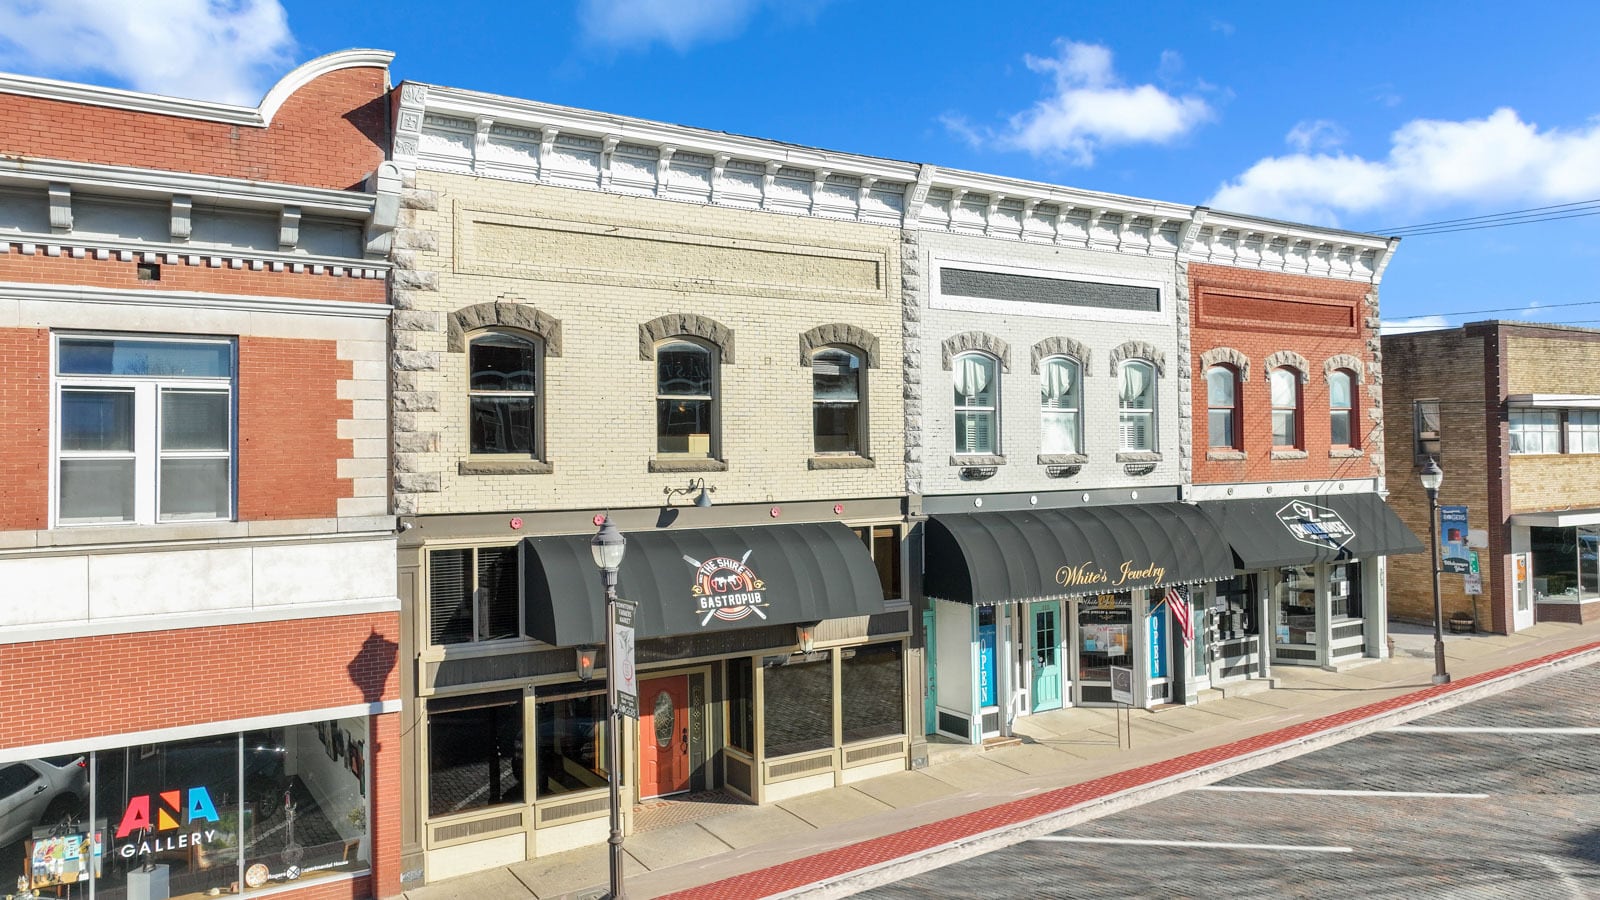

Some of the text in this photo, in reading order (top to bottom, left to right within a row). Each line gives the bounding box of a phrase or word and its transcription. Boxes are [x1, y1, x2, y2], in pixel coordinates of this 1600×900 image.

[701, 558, 744, 576] THE SHIRE
[1055, 560, 1166, 587] White's Jewelry
[700, 592, 762, 609] GASTROPUB
[1152, 616, 1160, 673] OPEN
[980, 638, 988, 702] OPEN
[115, 786, 220, 838] ANA
[121, 829, 215, 858] GALLERY
